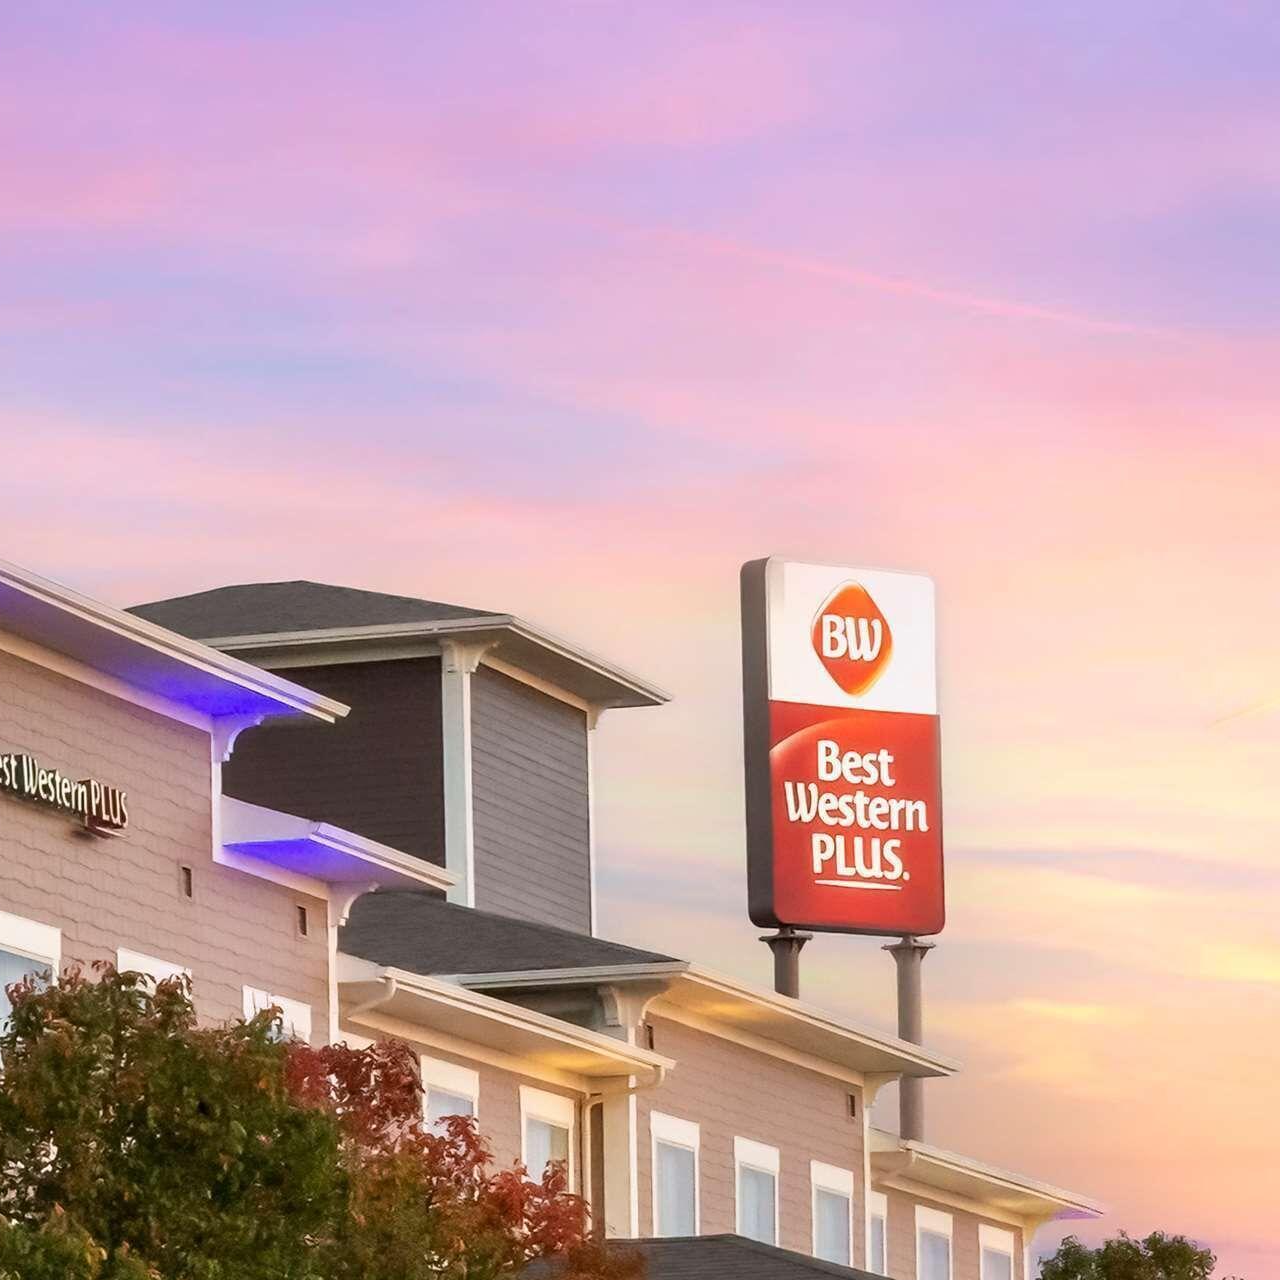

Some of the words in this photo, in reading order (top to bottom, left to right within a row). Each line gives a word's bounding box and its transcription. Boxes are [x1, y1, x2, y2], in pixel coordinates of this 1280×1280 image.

[822, 615, 882, 661] BW
[818, 740, 894, 786] Best
[22, 755, 87, 813] Western
[91, 780, 127, 828] PLUS
[784, 782, 928, 832] Western
